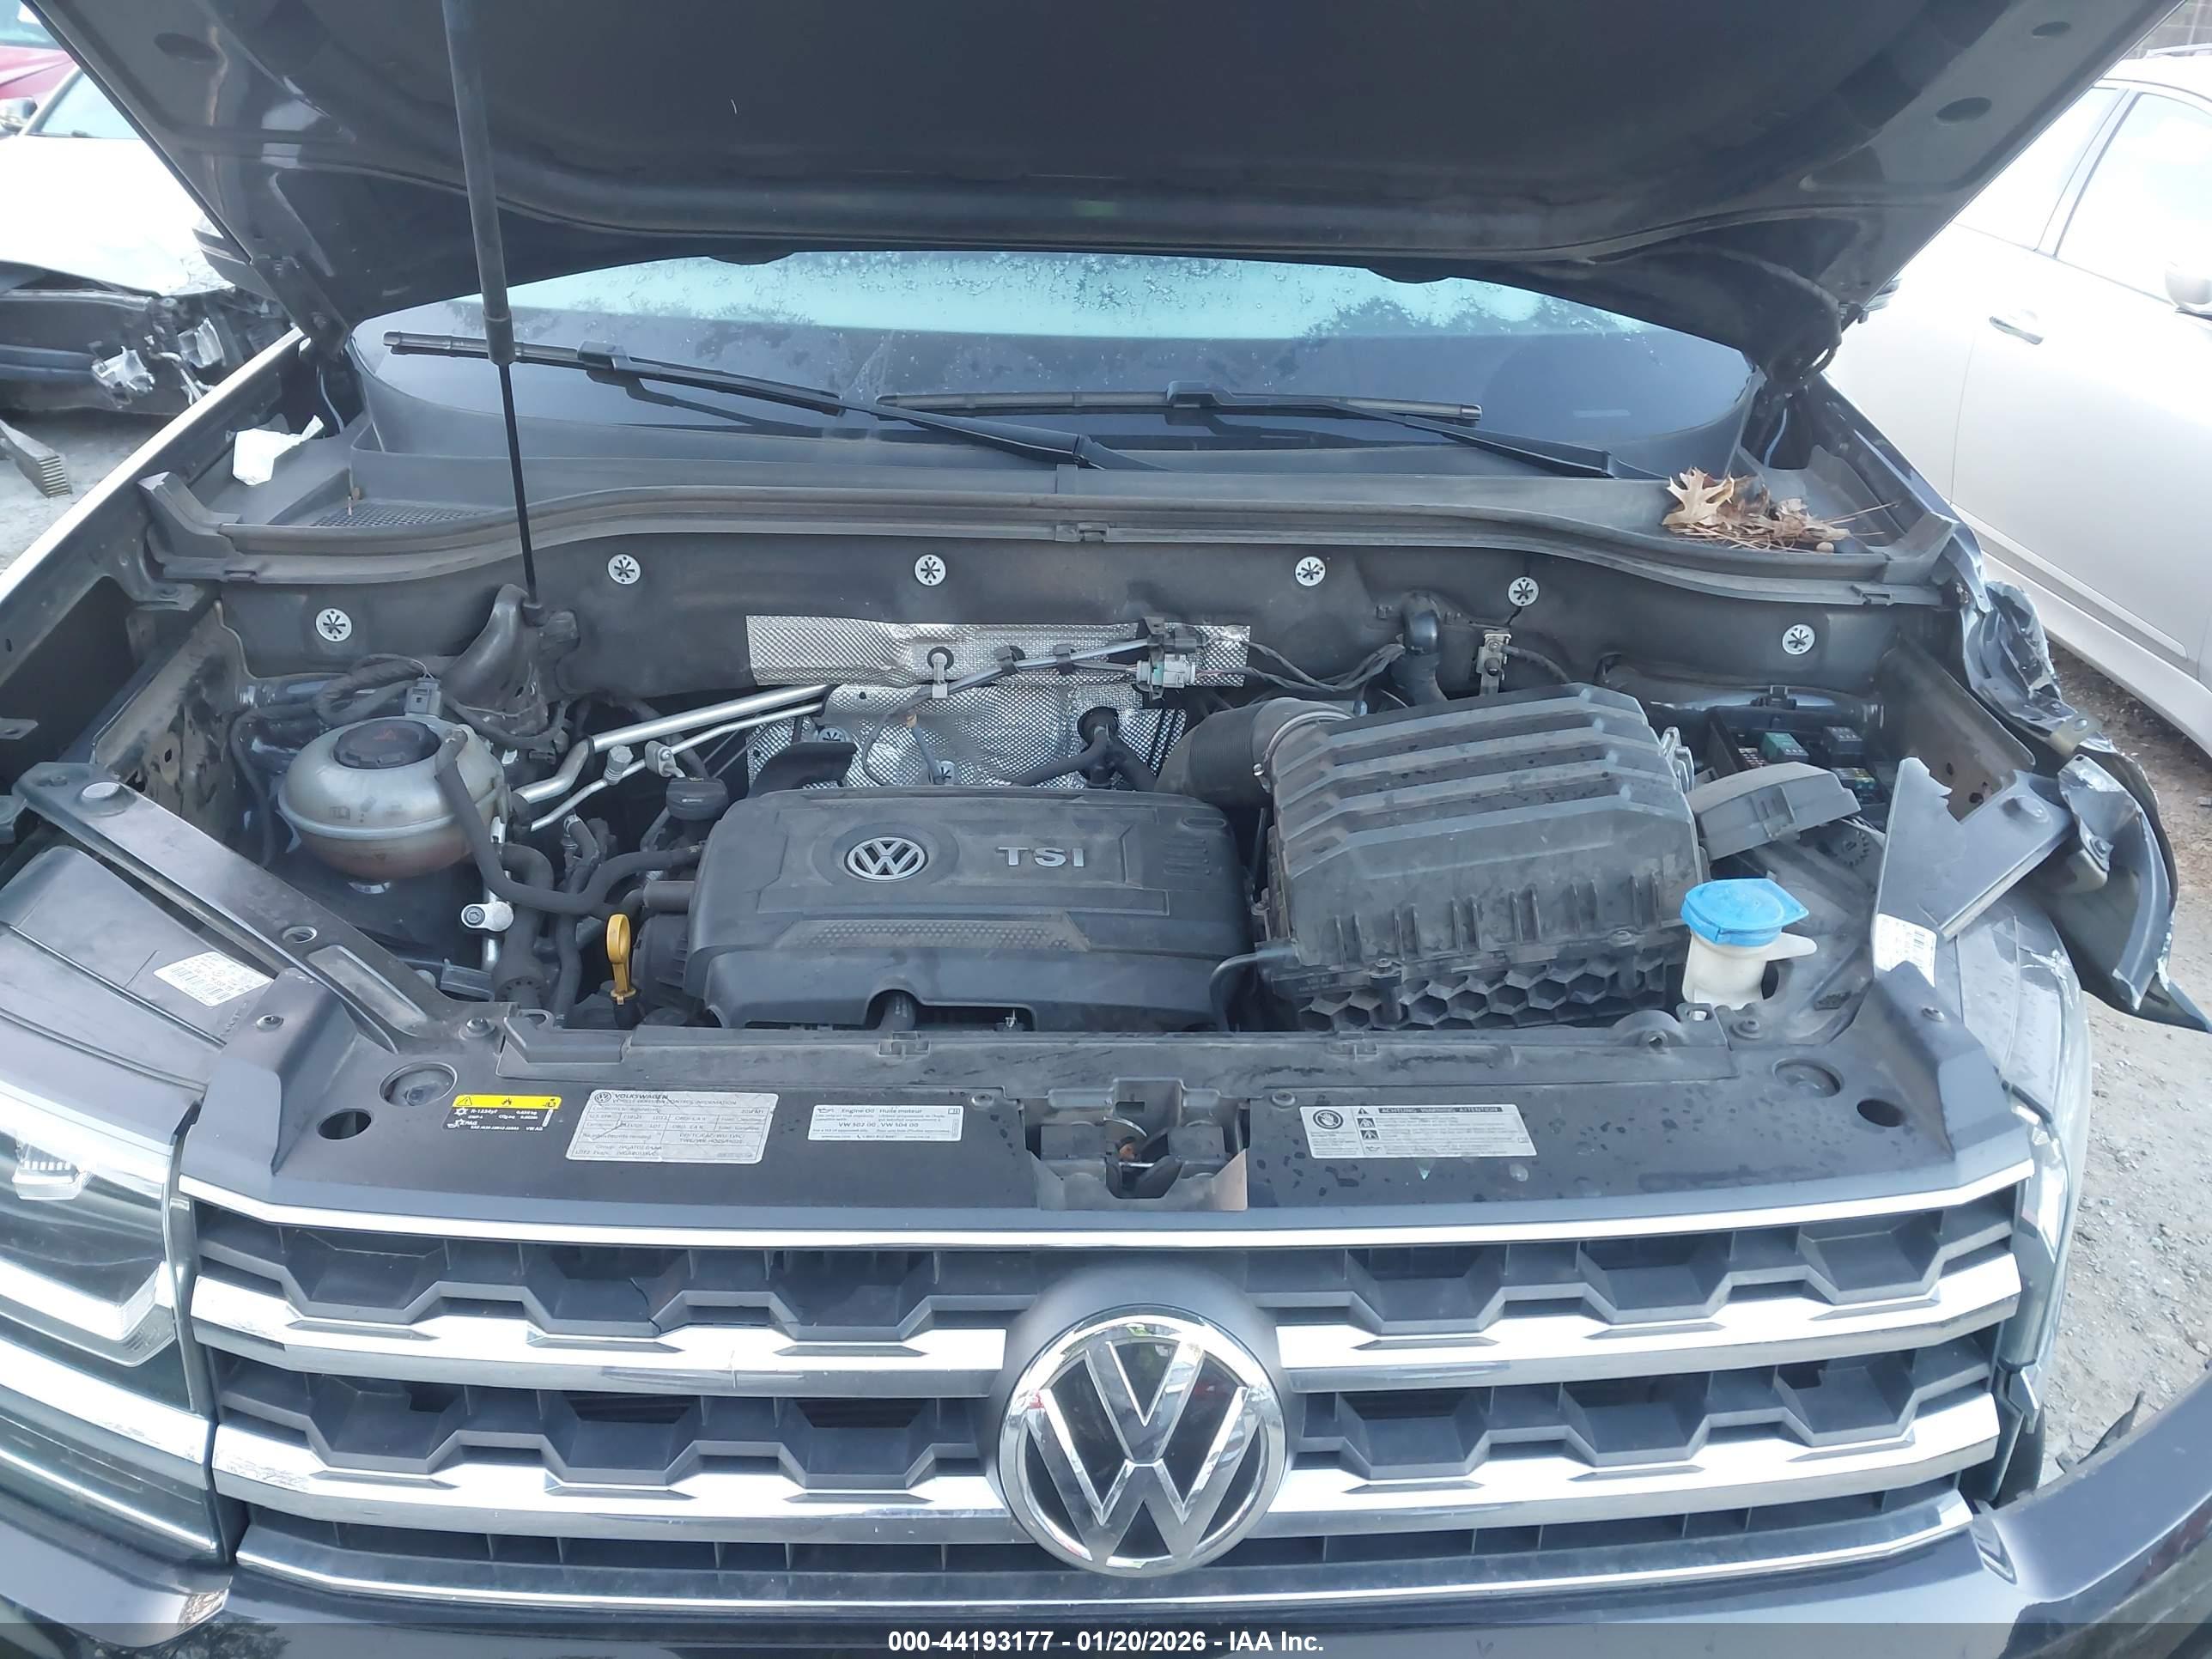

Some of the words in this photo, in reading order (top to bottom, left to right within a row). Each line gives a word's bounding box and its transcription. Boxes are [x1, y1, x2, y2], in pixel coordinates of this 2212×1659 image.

[847, 836, 927, 881] VW
[997, 846, 1085, 867] TSI
[1003, 1311, 1284, 1577] VW
